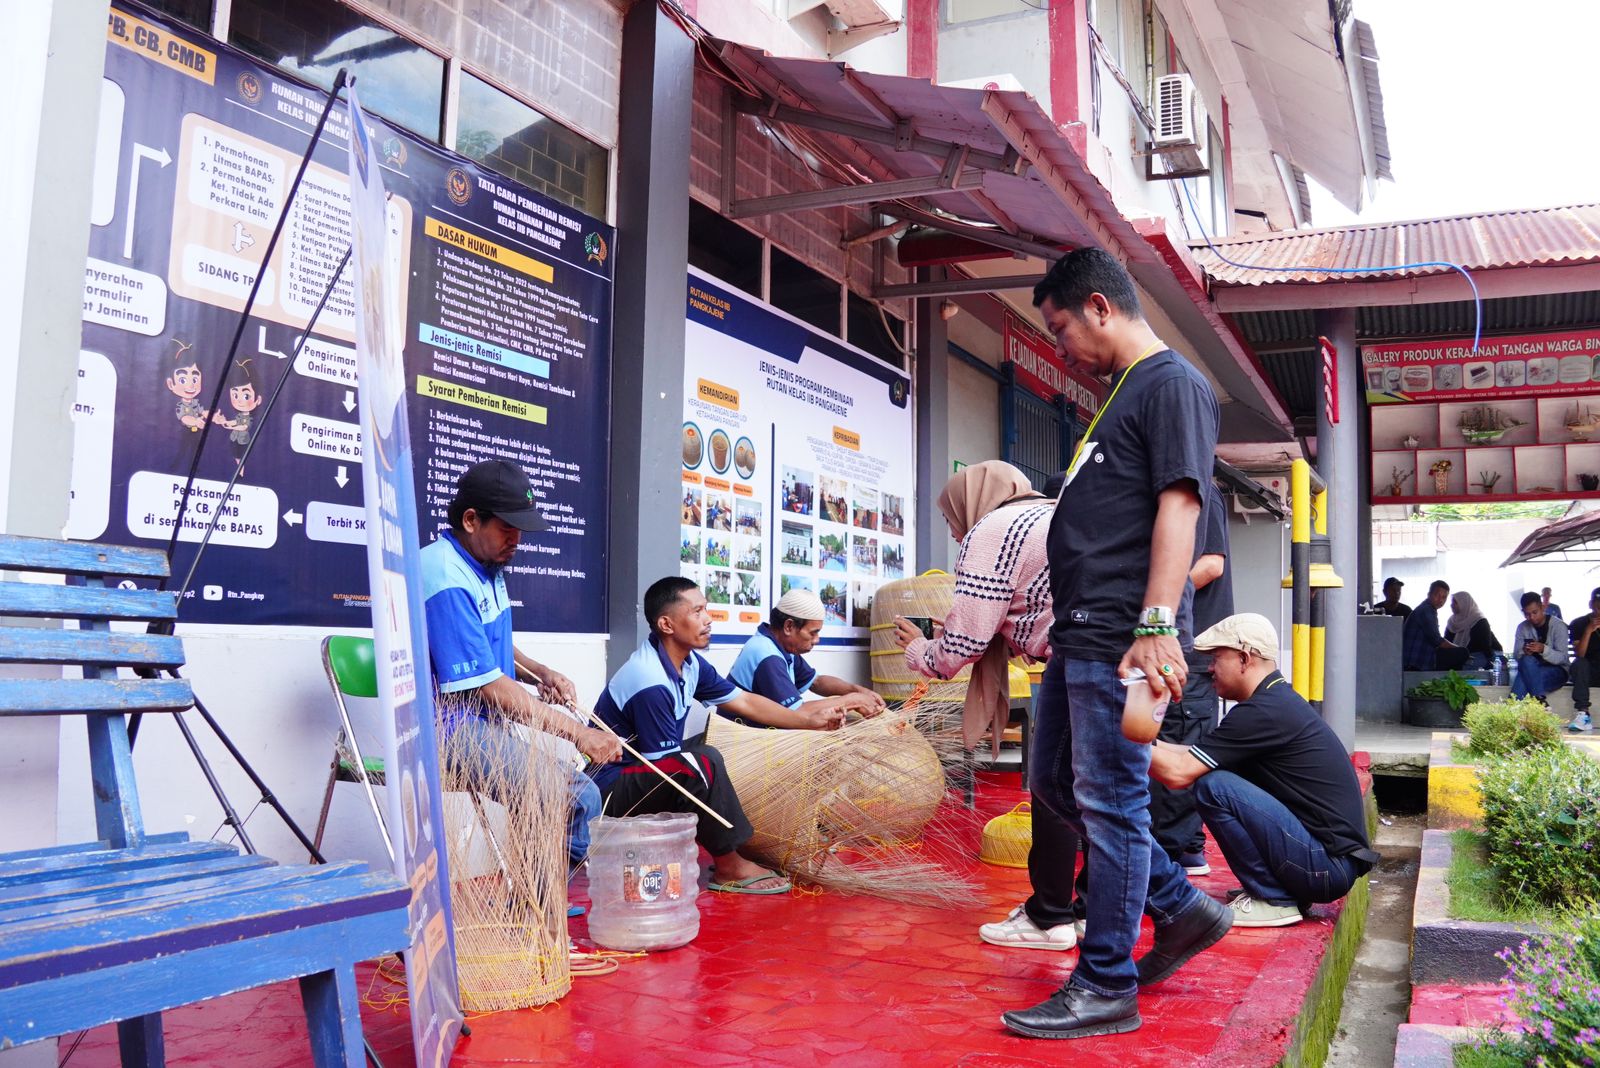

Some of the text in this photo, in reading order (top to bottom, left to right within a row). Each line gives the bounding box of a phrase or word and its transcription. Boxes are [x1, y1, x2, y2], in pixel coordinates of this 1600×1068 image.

[134, 26, 162, 56] CB,
[168, 40, 205, 72] CMB
[272, 82, 303, 105] RUMAH
[305, 98, 341, 122] TAHAAN
[278, 101, 304, 120] KELAS
[305, 112, 317, 126] IIB
[204, 137, 269, 168] 1. Permohonan
[201, 163, 267, 193] 2. Permohonan
[214, 154, 275, 184] Litmas BAPAS;
[212, 179, 274, 209] Ket. Tidak Ada
[302, 180, 340, 199] engumpulan
[210, 192, 268, 220] Perkara Lain;
[304, 205, 349, 226] Surat Jaminan
[305, 194, 351, 217] Surat Pernyata
[478, 177, 581, 233] TATA CARA PEMBERIAN REMISI
[494, 200, 566, 240] RUMAH TAHANAN NEGARA
[302, 224, 350, 246] Lembar perhitu
[438, 225, 497, 258] DASAR HUKUM
[498, 215, 516, 230] KELAS
[526, 228, 561, 249] PANGKAJENE
[301, 244, 332, 260] Ket. Tidak
[302, 236, 346, 255] Kutipan Putus
[300, 255, 321, 267] Litmas
[444, 250, 483, 272] Undang-Undang
[494, 269, 500, 277] 22
[516, 278, 527, 287] 2022
[86, 268, 143, 290] nyerahan
[199, 262, 254, 286] SIDANG TP
[299, 265, 325, 280] Laporan
[299, 275, 323, 288] Salinan
[86, 286, 132, 303] ormulir
[302, 287, 322, 298] Daftar
[302, 297, 318, 307] Hasil
[98, 303, 148, 324] Jaminan
[500, 304, 509, 313] 174
[524, 314, 535, 322] 1999
[690, 298, 724, 319] PANGKAJENE
[305, 346, 356, 366] Pengiriman
[431, 331, 501, 362] Jenis-jenis Remisi
[1010, 335, 1037, 377] KEJADIAN
[1366, 351, 1400, 363] GALERY
[1404, 349, 1443, 361] PRODUK
[1446, 345, 1500, 359] KERAJINAN
[1502, 342, 1543, 355] TANGAN
[1547, 340, 1582, 352] WARGA
[308, 362, 350, 380] Online Ke
[434, 351, 451, 363] Remisi
[453, 356, 470, 369] Umum,
[472, 362, 488, 374] Remisi
[490, 366, 506, 379] Khusus
[508, 371, 518, 382] Hari
[533, 379, 547, 390] Remisi
[549, 384, 571, 396] Tambahan
[434, 363, 485, 384] Remisi Kemanusiaan
[760, 360, 853, 407] JENIS-JENIS PROGRAM PEMBINAAN
[429, 381, 527, 415] Syarat Pemberian Remisi
[700, 385, 737, 404] KEMANDIRIAN
[767, 378, 787, 394] RUTAN
[789, 386, 806, 401] KELAS
[815, 396, 847, 417] PANGKAJENE
[436, 423, 450, 433] Telah
[437, 411, 469, 426] Berkelakuan
[302, 423, 353, 441] Pengiriman
[308, 439, 350, 455] Online Ke
[173, 484, 241, 501] Peaksanan
[196, 503, 211, 515] CB,
[144, 514, 154, 524] di
[215, 521, 226, 532] ke
[231, 524, 262, 535] BAPAS
[327, 517, 366, 530] Terbit SK
